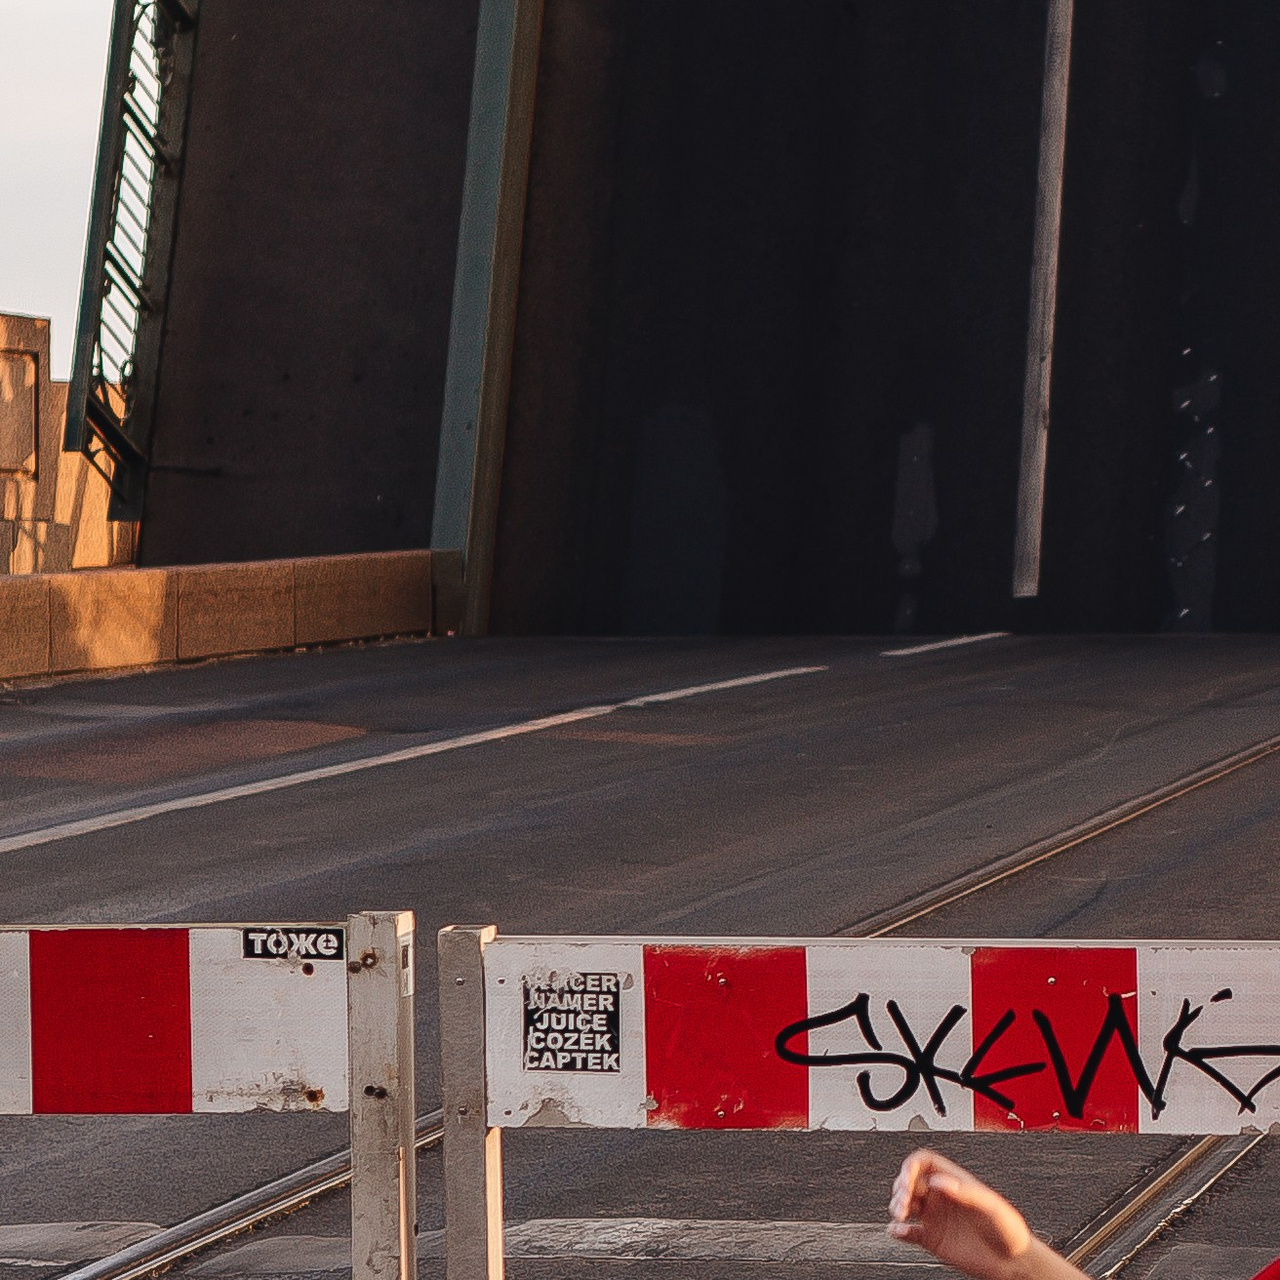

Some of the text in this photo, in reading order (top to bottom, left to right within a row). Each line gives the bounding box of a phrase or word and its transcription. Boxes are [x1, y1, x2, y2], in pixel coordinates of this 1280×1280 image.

[535, 1013, 608, 1032] JUICE
[530, 1032, 613, 1051] COZEK
[525, 1051, 620, 1070] CAPTEK
